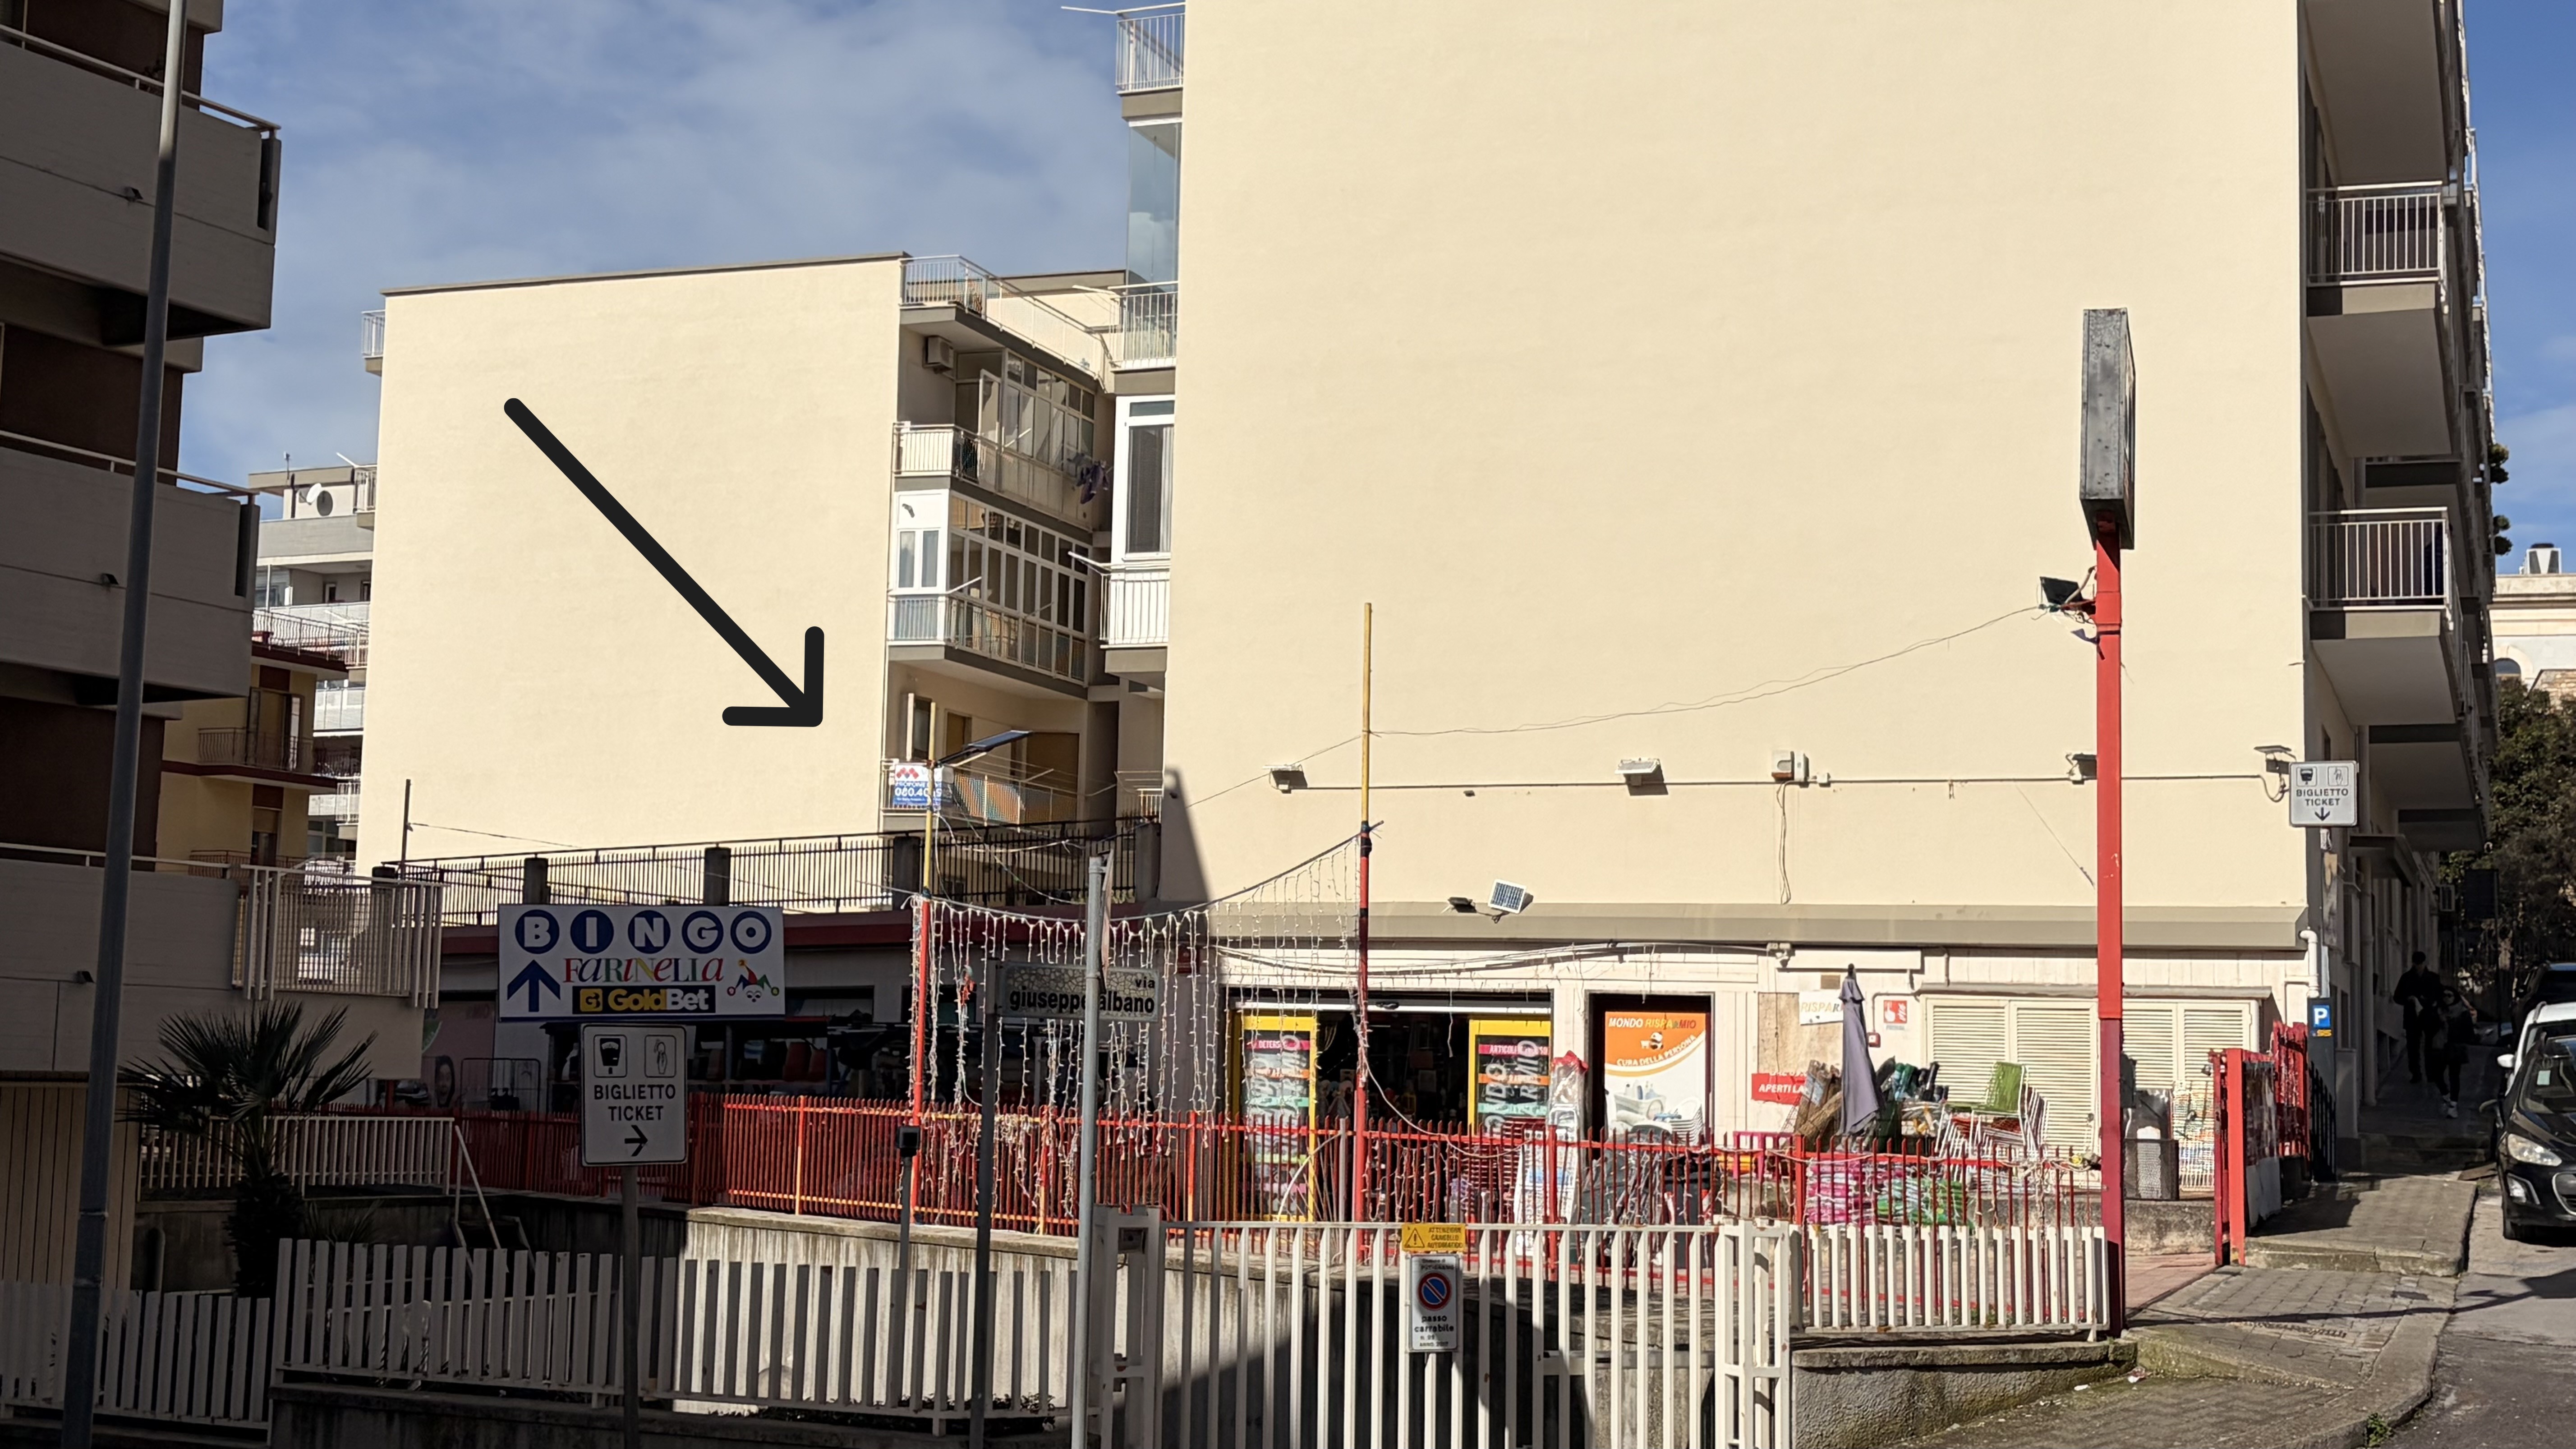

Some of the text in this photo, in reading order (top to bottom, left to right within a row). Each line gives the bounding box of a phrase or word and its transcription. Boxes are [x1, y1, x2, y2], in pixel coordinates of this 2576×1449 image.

[2296, 788, 2349, 796] BIGLIETTO
[521, 914, 769, 950] BINGO
[1135, 976, 1155, 989] via
[608, 989, 709, 1011] GoldBet
[1099, 990, 1155, 1013] albano
[1800, 1002, 1845, 1013] RISPAR
[1609, 1017, 1697, 1029] MONDO RISPARMIO
[2314, 1007, 2328, 1025] P
[1639, 1054, 1664, 1066] DELLA
[1664, 1035, 1697, 1058] PERSONA
[594, 1084, 676, 1100] BIGLIETTO
[1759, 1084, 1792, 1094] APERTI
[608, 1105, 664, 1121] TICKET
[1414, 1324, 1454, 1333] carrabile
